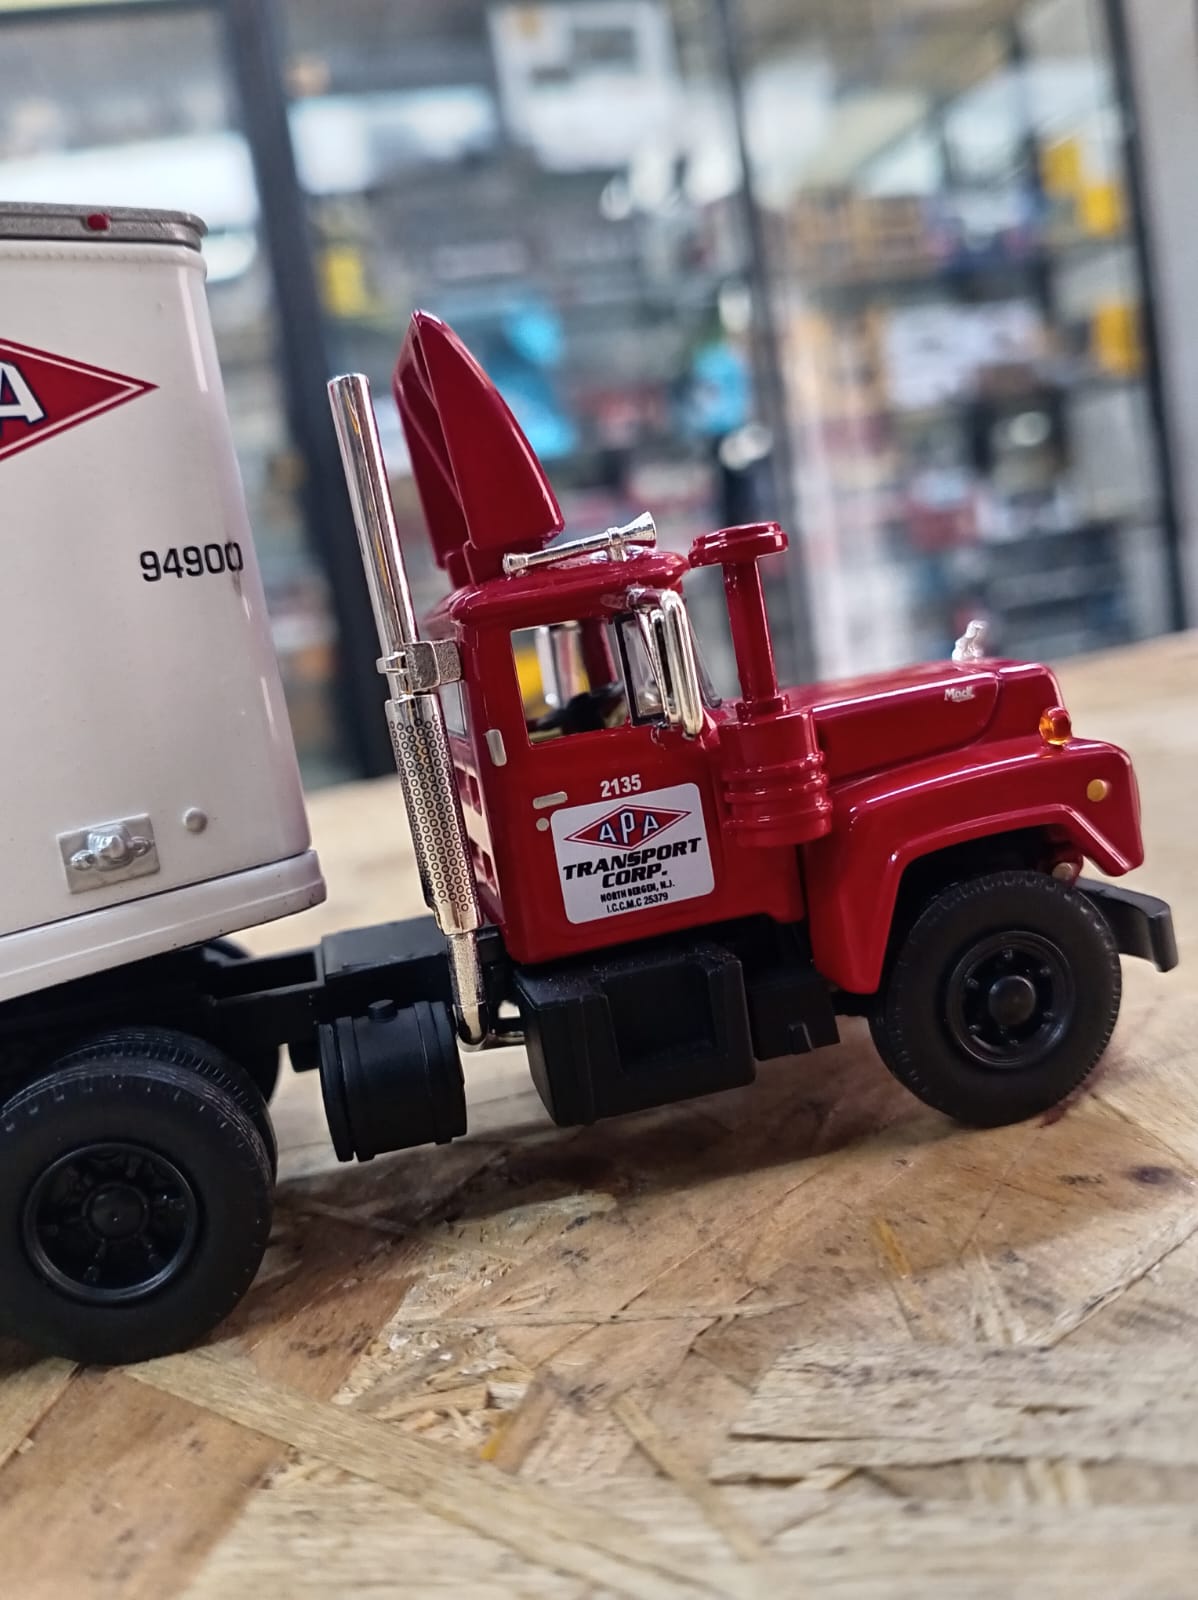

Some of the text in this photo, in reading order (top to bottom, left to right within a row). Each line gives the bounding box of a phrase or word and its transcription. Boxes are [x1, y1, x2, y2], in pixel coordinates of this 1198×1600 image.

[139, 541, 244, 582] 94900
[600, 774, 642, 798] 2135
[599, 811, 660, 844] APA
[563, 837, 702, 881] TRANSPORT
[602, 863, 668, 889] CORP.
[600, 879, 676, 903] NORTH BERGEN, N.J.
[643, 892, 669, 905] 25379
